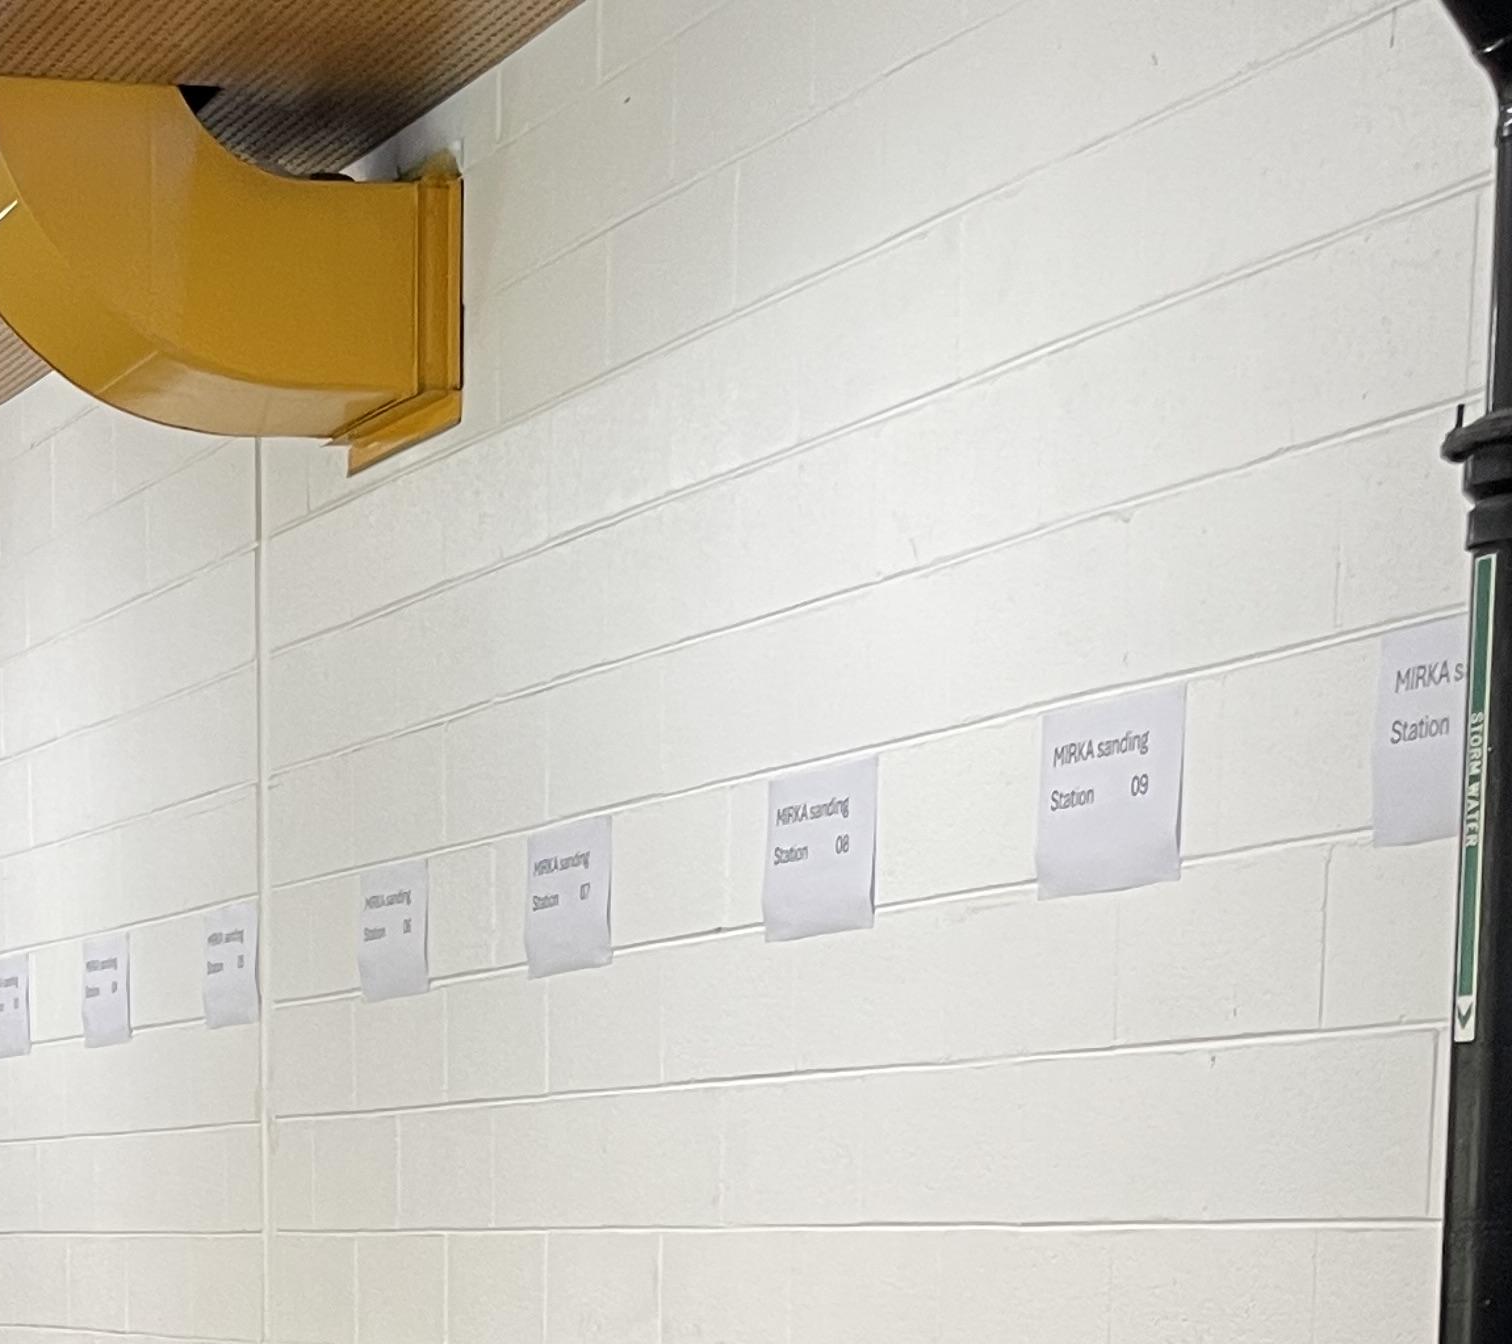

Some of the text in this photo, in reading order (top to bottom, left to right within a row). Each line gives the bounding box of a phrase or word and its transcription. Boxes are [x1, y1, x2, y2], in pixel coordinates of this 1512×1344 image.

[1394, 660, 1450, 694] MIRKA
[1390, 715, 1449, 744] Station
[1053, 730, 1150, 767] MIRKA sanding
[1051, 773, 1149, 812] Station 09
[1465, 711, 1484, 847] STORM WATER
[810, 796, 850, 819] sanding
[774, 844, 808, 865] Station
